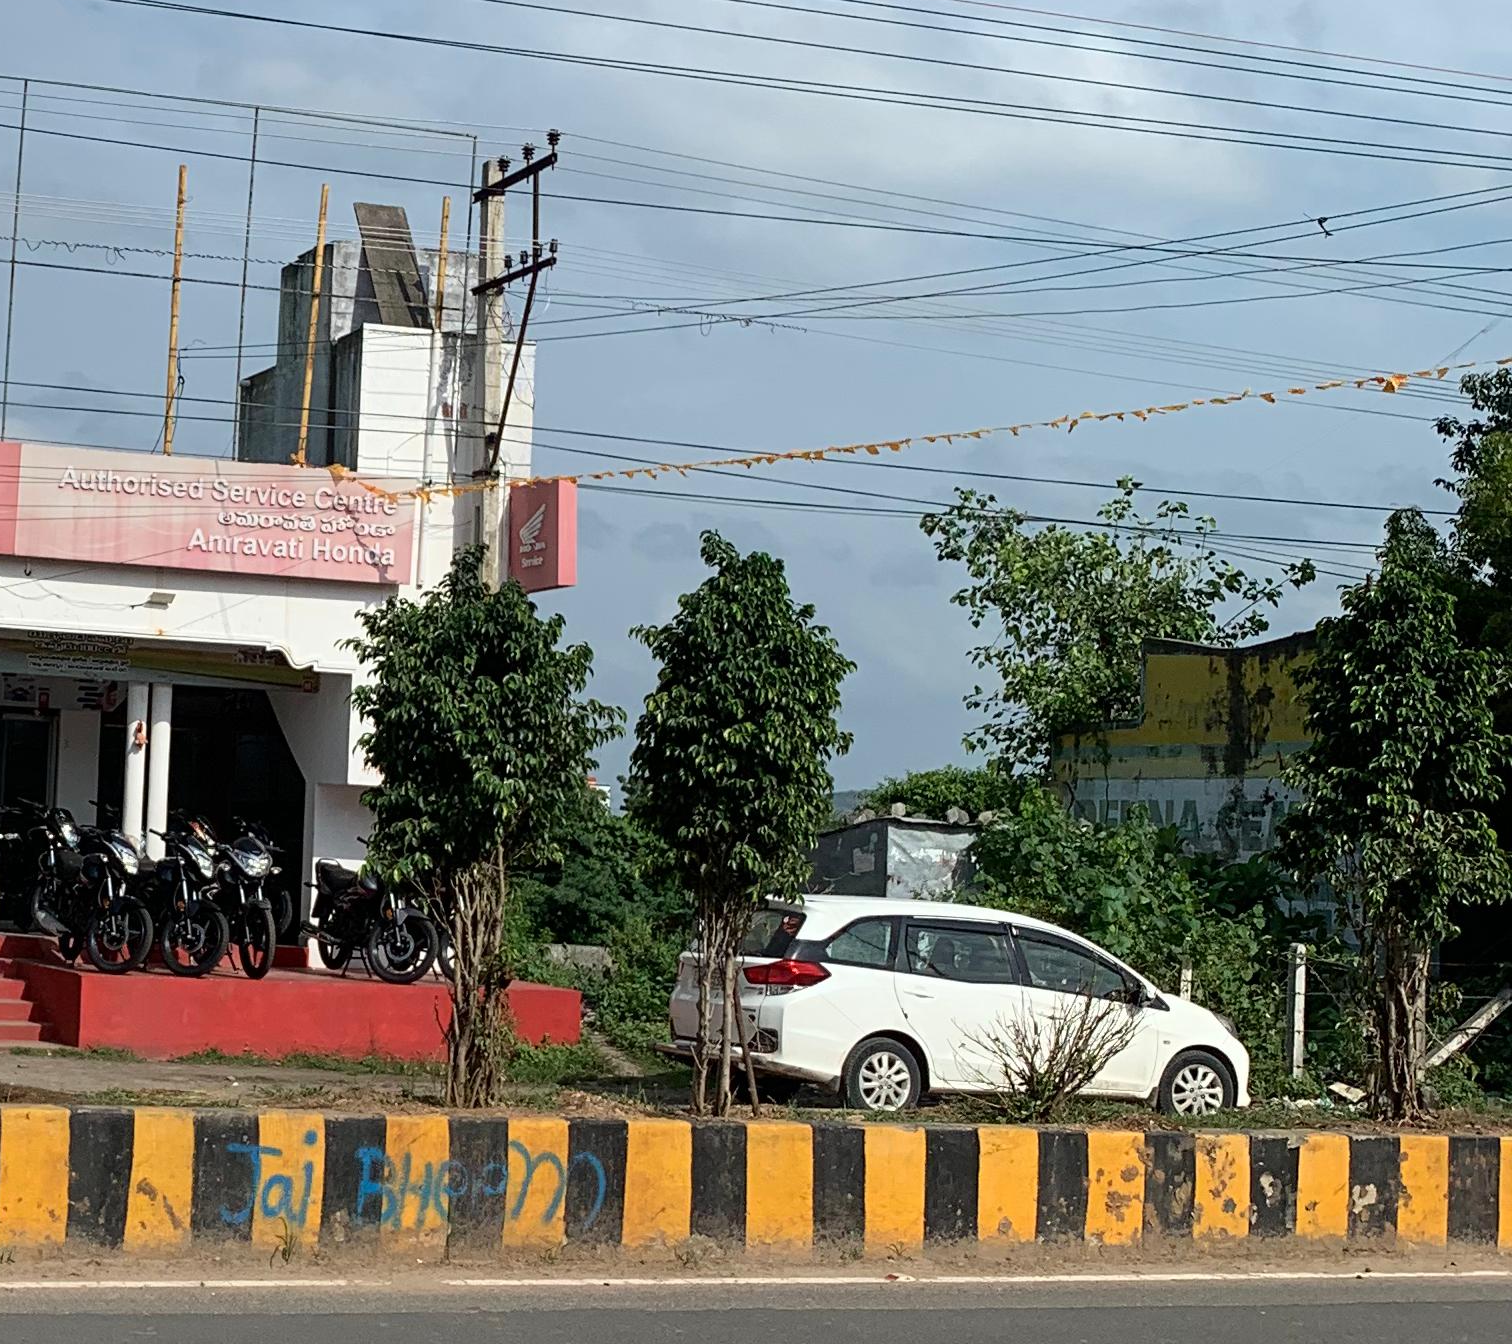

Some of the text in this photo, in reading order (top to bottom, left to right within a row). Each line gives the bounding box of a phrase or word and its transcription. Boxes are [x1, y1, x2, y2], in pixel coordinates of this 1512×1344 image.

[59, 465, 398, 516] Authorised Service Centre
[187, 527, 396, 567] Amravati Honda
[218, 1129, 318, 1228] Jai
